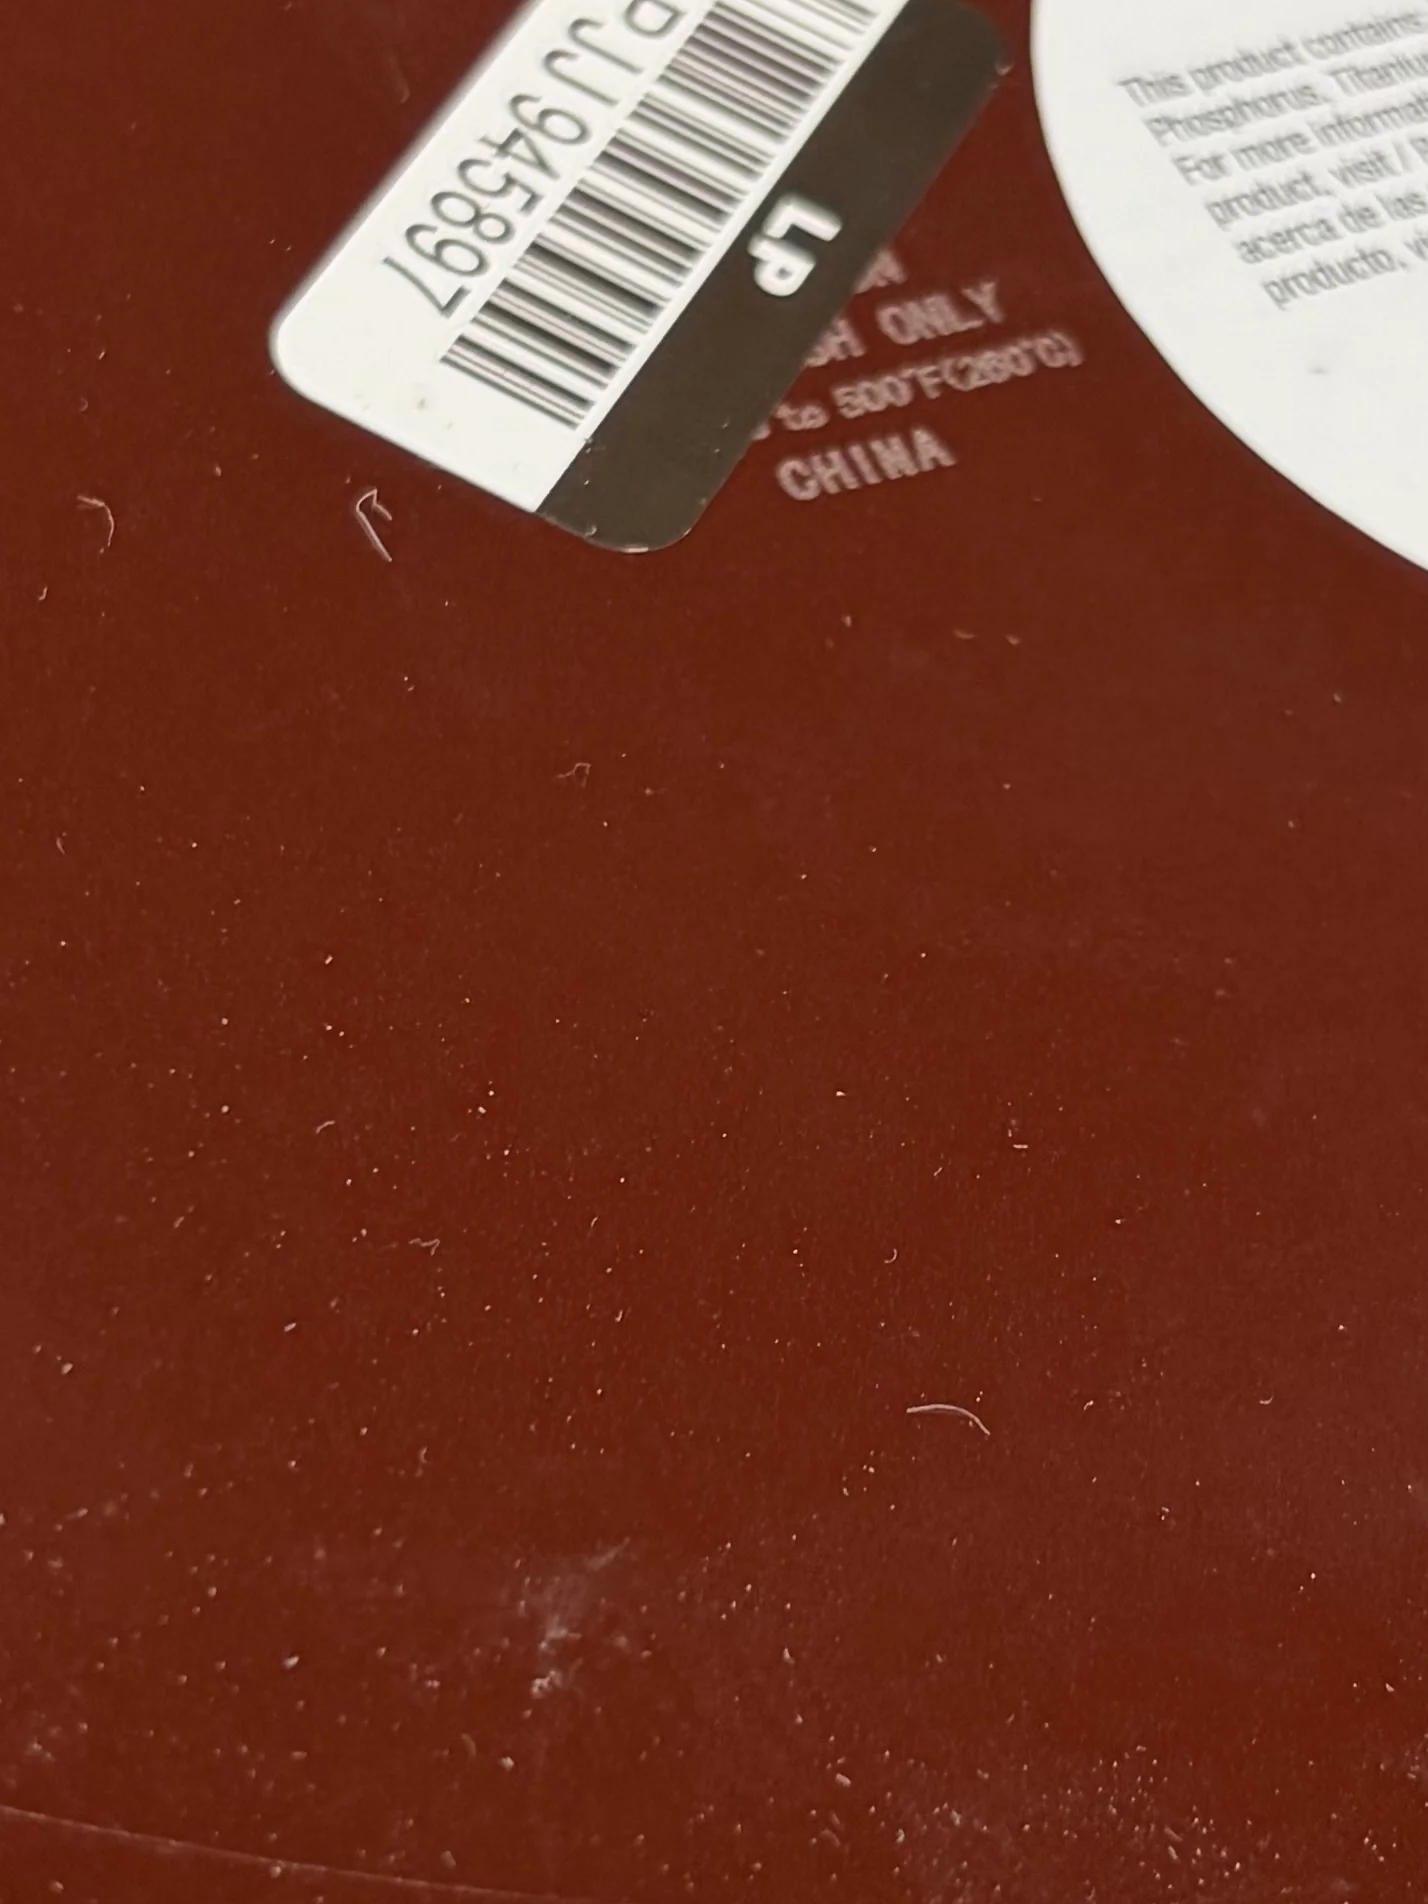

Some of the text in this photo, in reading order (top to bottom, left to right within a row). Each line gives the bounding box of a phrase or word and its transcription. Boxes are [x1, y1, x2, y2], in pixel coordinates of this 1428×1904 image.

[1118, 73, 1196, 107] This
[1187, 39, 1308, 96] product
[1171, 151, 1232, 186] For
[1227, 130, 1319, 171] more
[1327, 148, 1404, 189] visit
[746, 198, 843, 296] LP
[1232, 217, 1345, 265] acerca
[1334, 200, 1387, 235] de
[875, 278, 1007, 346] ONLY
[1260, 245, 1410, 312] producto,
[773, 401, 831, 432] to
[774, 427, 958, 502] CHINA
